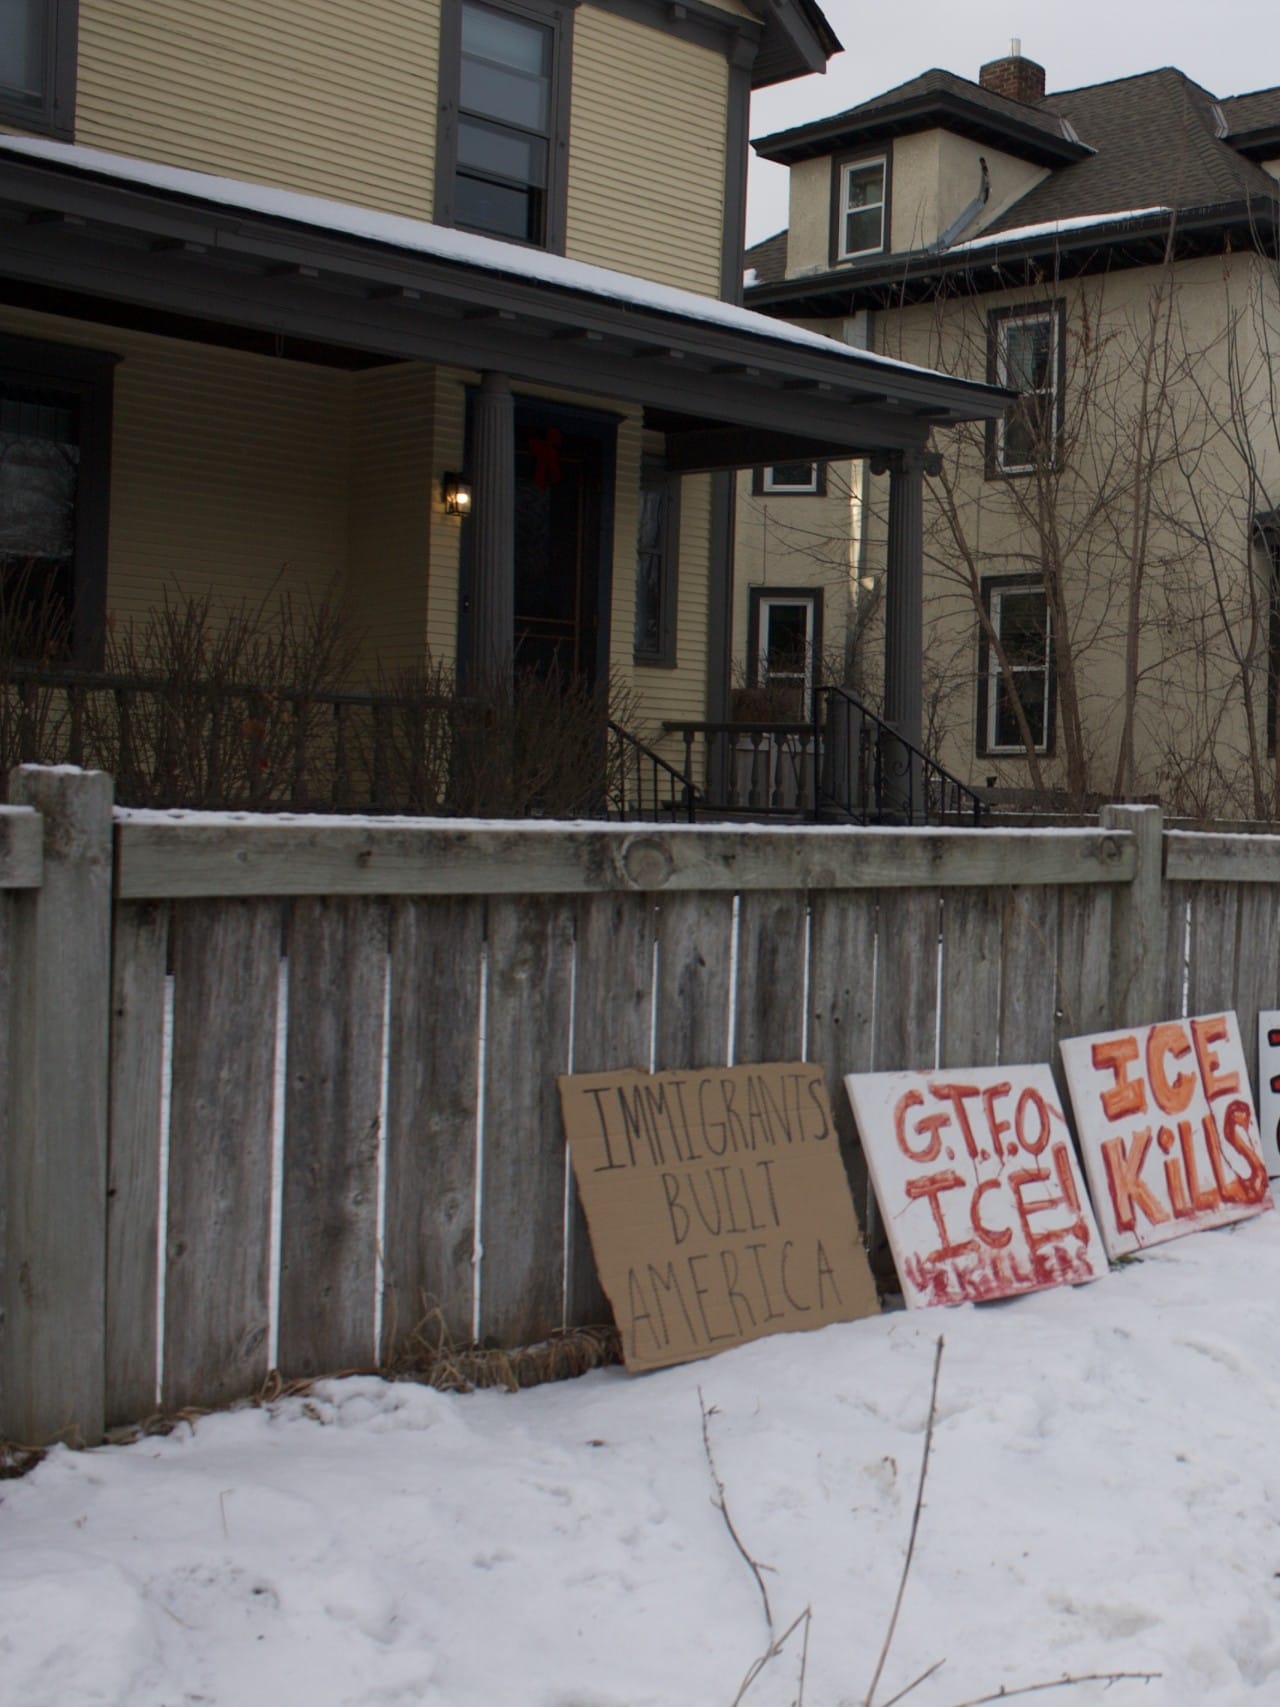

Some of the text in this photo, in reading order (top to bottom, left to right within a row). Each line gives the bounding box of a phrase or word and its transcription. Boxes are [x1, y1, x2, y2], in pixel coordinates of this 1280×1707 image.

[1091, 1016, 1243, 1121] ICE
[583, 1074, 829, 1172] IMMIGRANTS
[662, 1159, 781, 1245] BUILT
[629, 1239, 843, 1359] AMERICA
